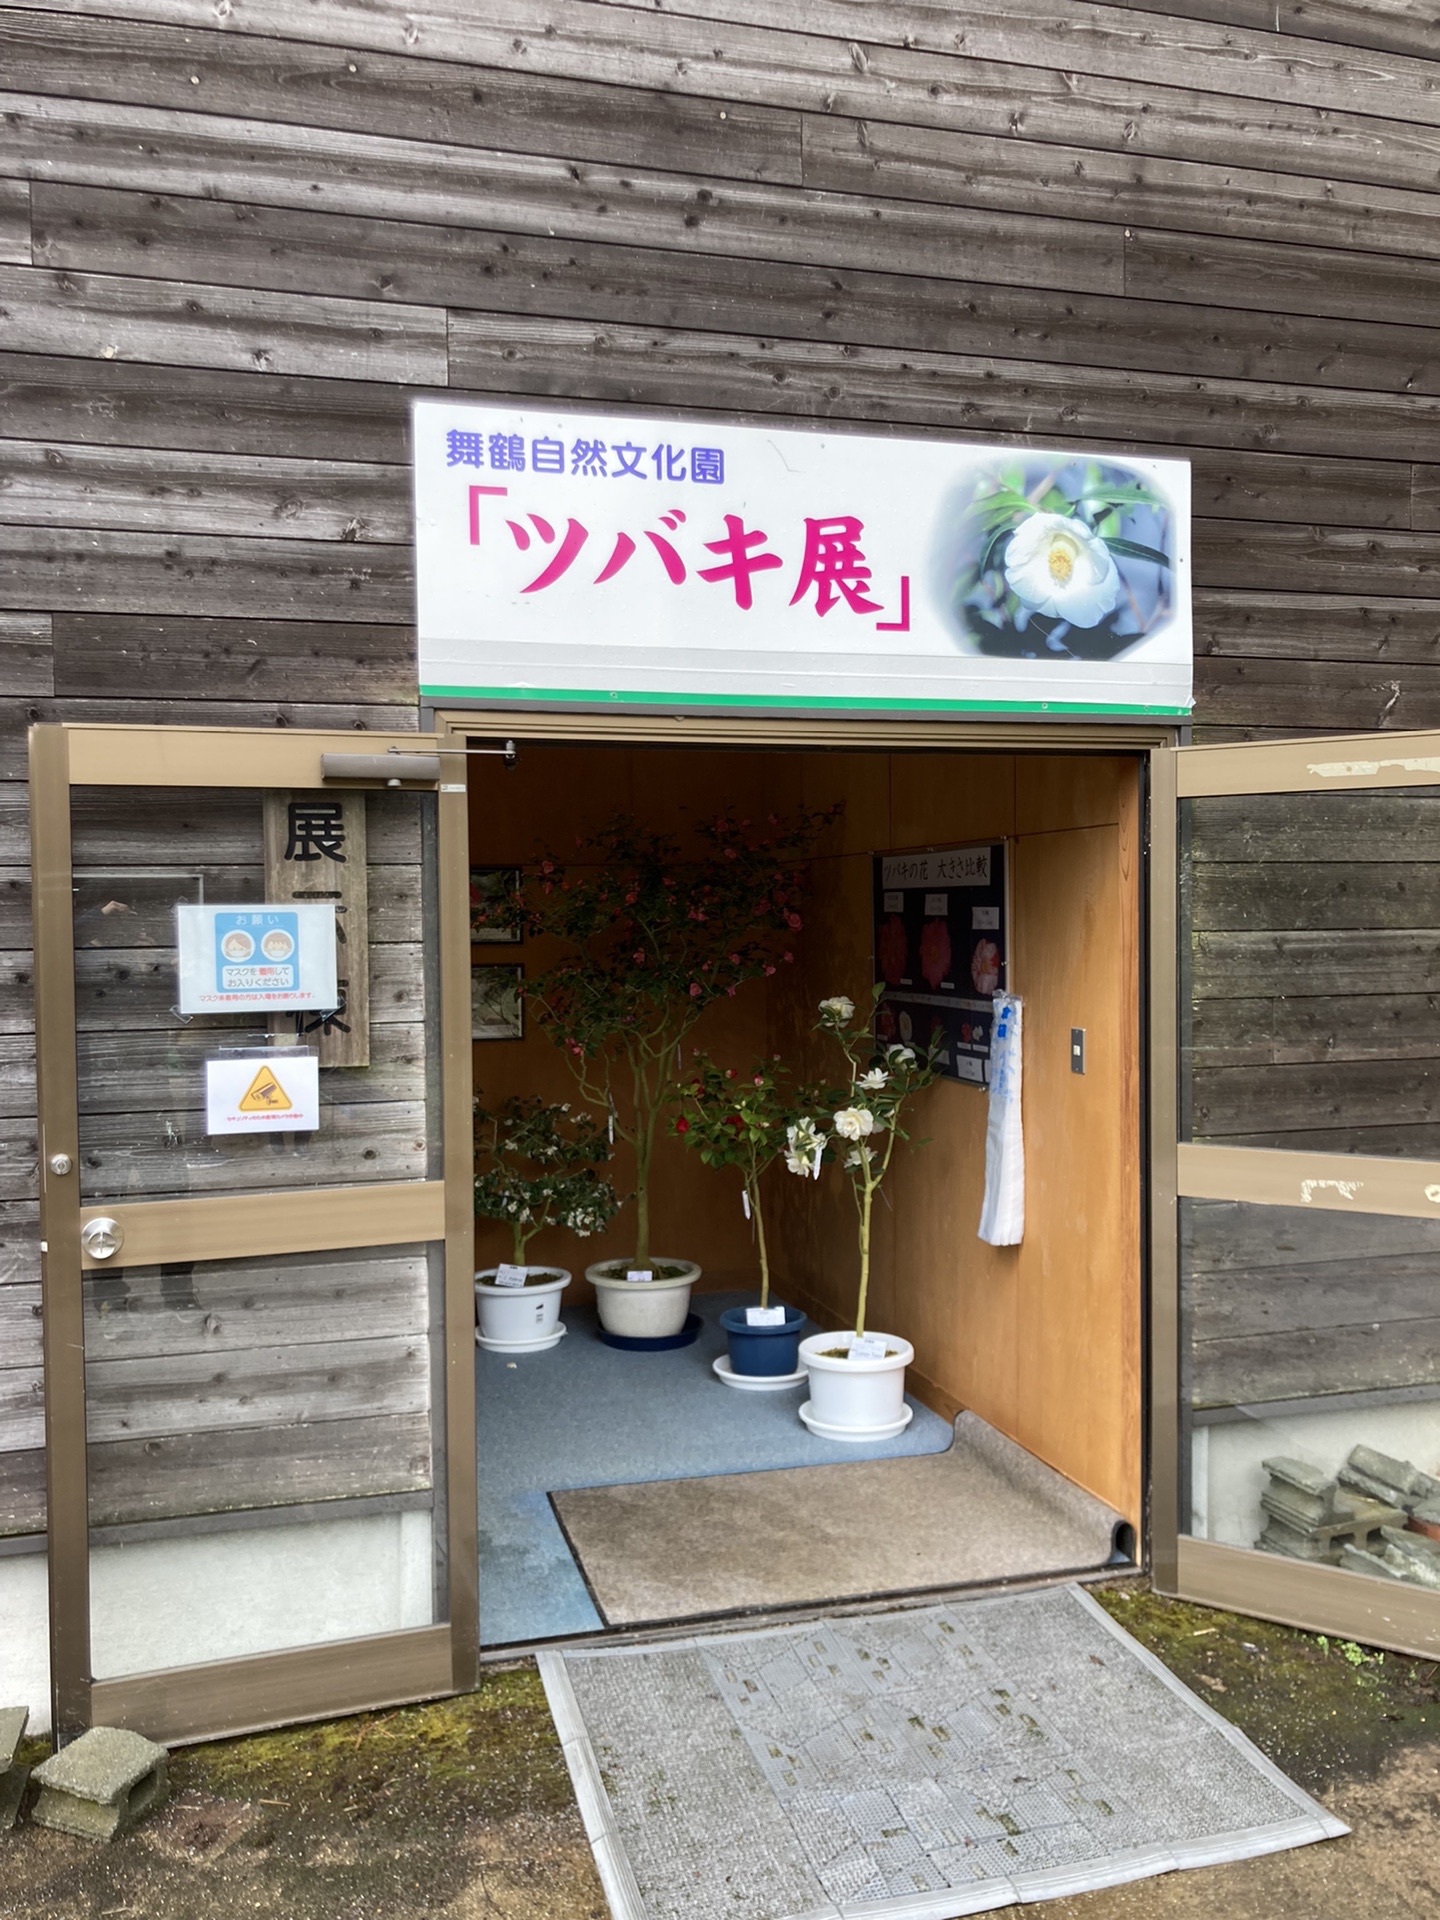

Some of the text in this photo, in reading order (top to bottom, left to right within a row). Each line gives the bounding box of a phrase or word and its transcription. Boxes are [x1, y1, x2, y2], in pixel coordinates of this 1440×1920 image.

[446, 428, 726, 486] 舞鶴自然文化園
[468, 485, 911, 632] 「ツバキ展」
[235, 914, 280, 926] お願い
[227, 977, 290, 988] お入りください
